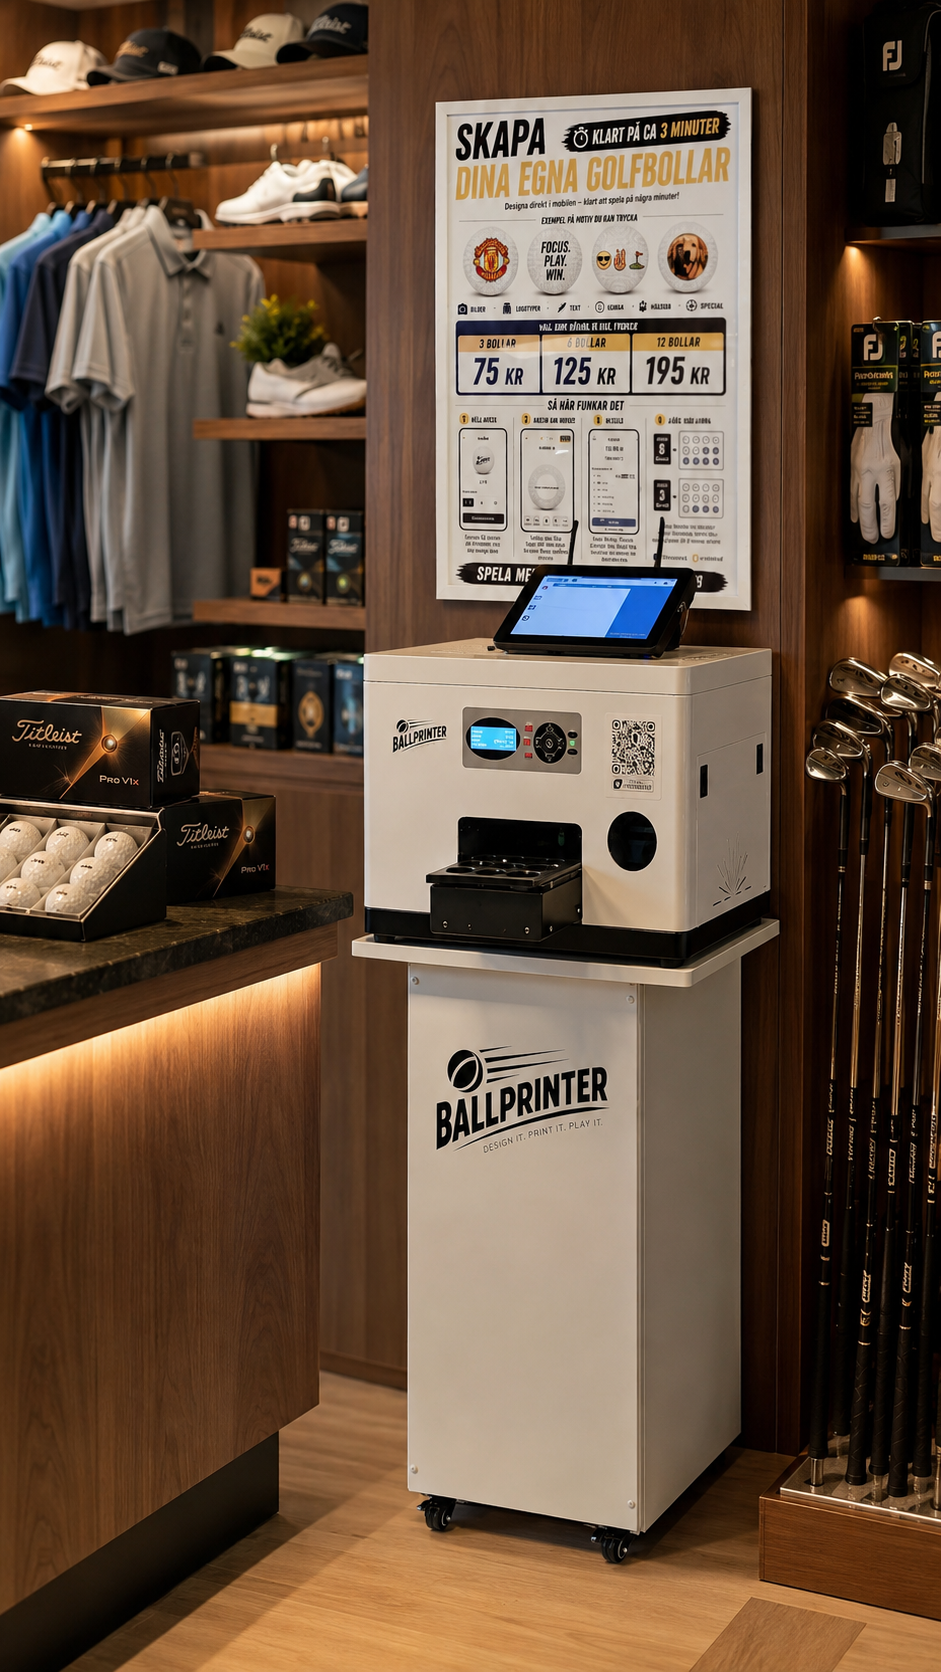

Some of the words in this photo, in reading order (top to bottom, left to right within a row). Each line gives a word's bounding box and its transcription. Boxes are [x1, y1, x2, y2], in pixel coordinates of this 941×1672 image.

[883, 40, 902, 71] FJ
[455, 118, 545, 161] SKAPA
[592, 127, 625, 145] KLART
[627, 121, 640, 142] PÅ
[643, 123, 657, 140] CA
[660, 122, 668, 138] 3
[670, 117, 720, 138] MINUTER
[455, 163, 510, 200] DINA
[518, 158, 578, 196] EGNA
[586, 147, 731, 192] GOLFBOLLAR
[504, 202, 529, 212] Designa
[529, 200, 548, 209] direkt
[583, 197, 597, 205] klart
[625, 194, 634, 204] på
[541, 241, 571, 254] FOCUS.
[544, 254, 567, 267] PLAY.
[546, 268, 565, 281] WIN.
[479, 339, 485, 349] 3
[486, 338, 516, 349] BOLLAR
[567, 337, 572, 348] 6
[575, 337, 606, 348] BOLLAR
[657, 337, 665, 347] 12
[668, 337, 701, 347] BOLLAR
[863, 334, 883, 360] FJ
[473, 357, 500, 385] 75
[505, 367, 524, 386] KR
[554, 356, 592, 385] 125
[597, 367, 616, 385] KR
[646, 356, 686, 385] 195
[690, 366, 710, 385] KR
[547, 398, 558, 411] SÅ
[577, 400, 608, 411] FUNKAR
[609, 400, 625, 411] DET
[476, 566, 511, 582] SPELA
[515, 568, 535, 582] ME
[12, 719, 82, 744] Titleist
[392, 725, 447, 753] BALLPRINTER
[176, 822, 230, 847] Titleist
[436, 1066, 608, 1150] BALLPRINTER
[482, 1137, 514, 1153] DESIGN
[515, 1133, 526, 1143] IT.
[528, 1126, 553, 1139] PRINT
[555, 1123, 567, 1132] IT.
[568, 1120, 590, 1130] PLAY
[593, 1118, 603, 1126] IT.
